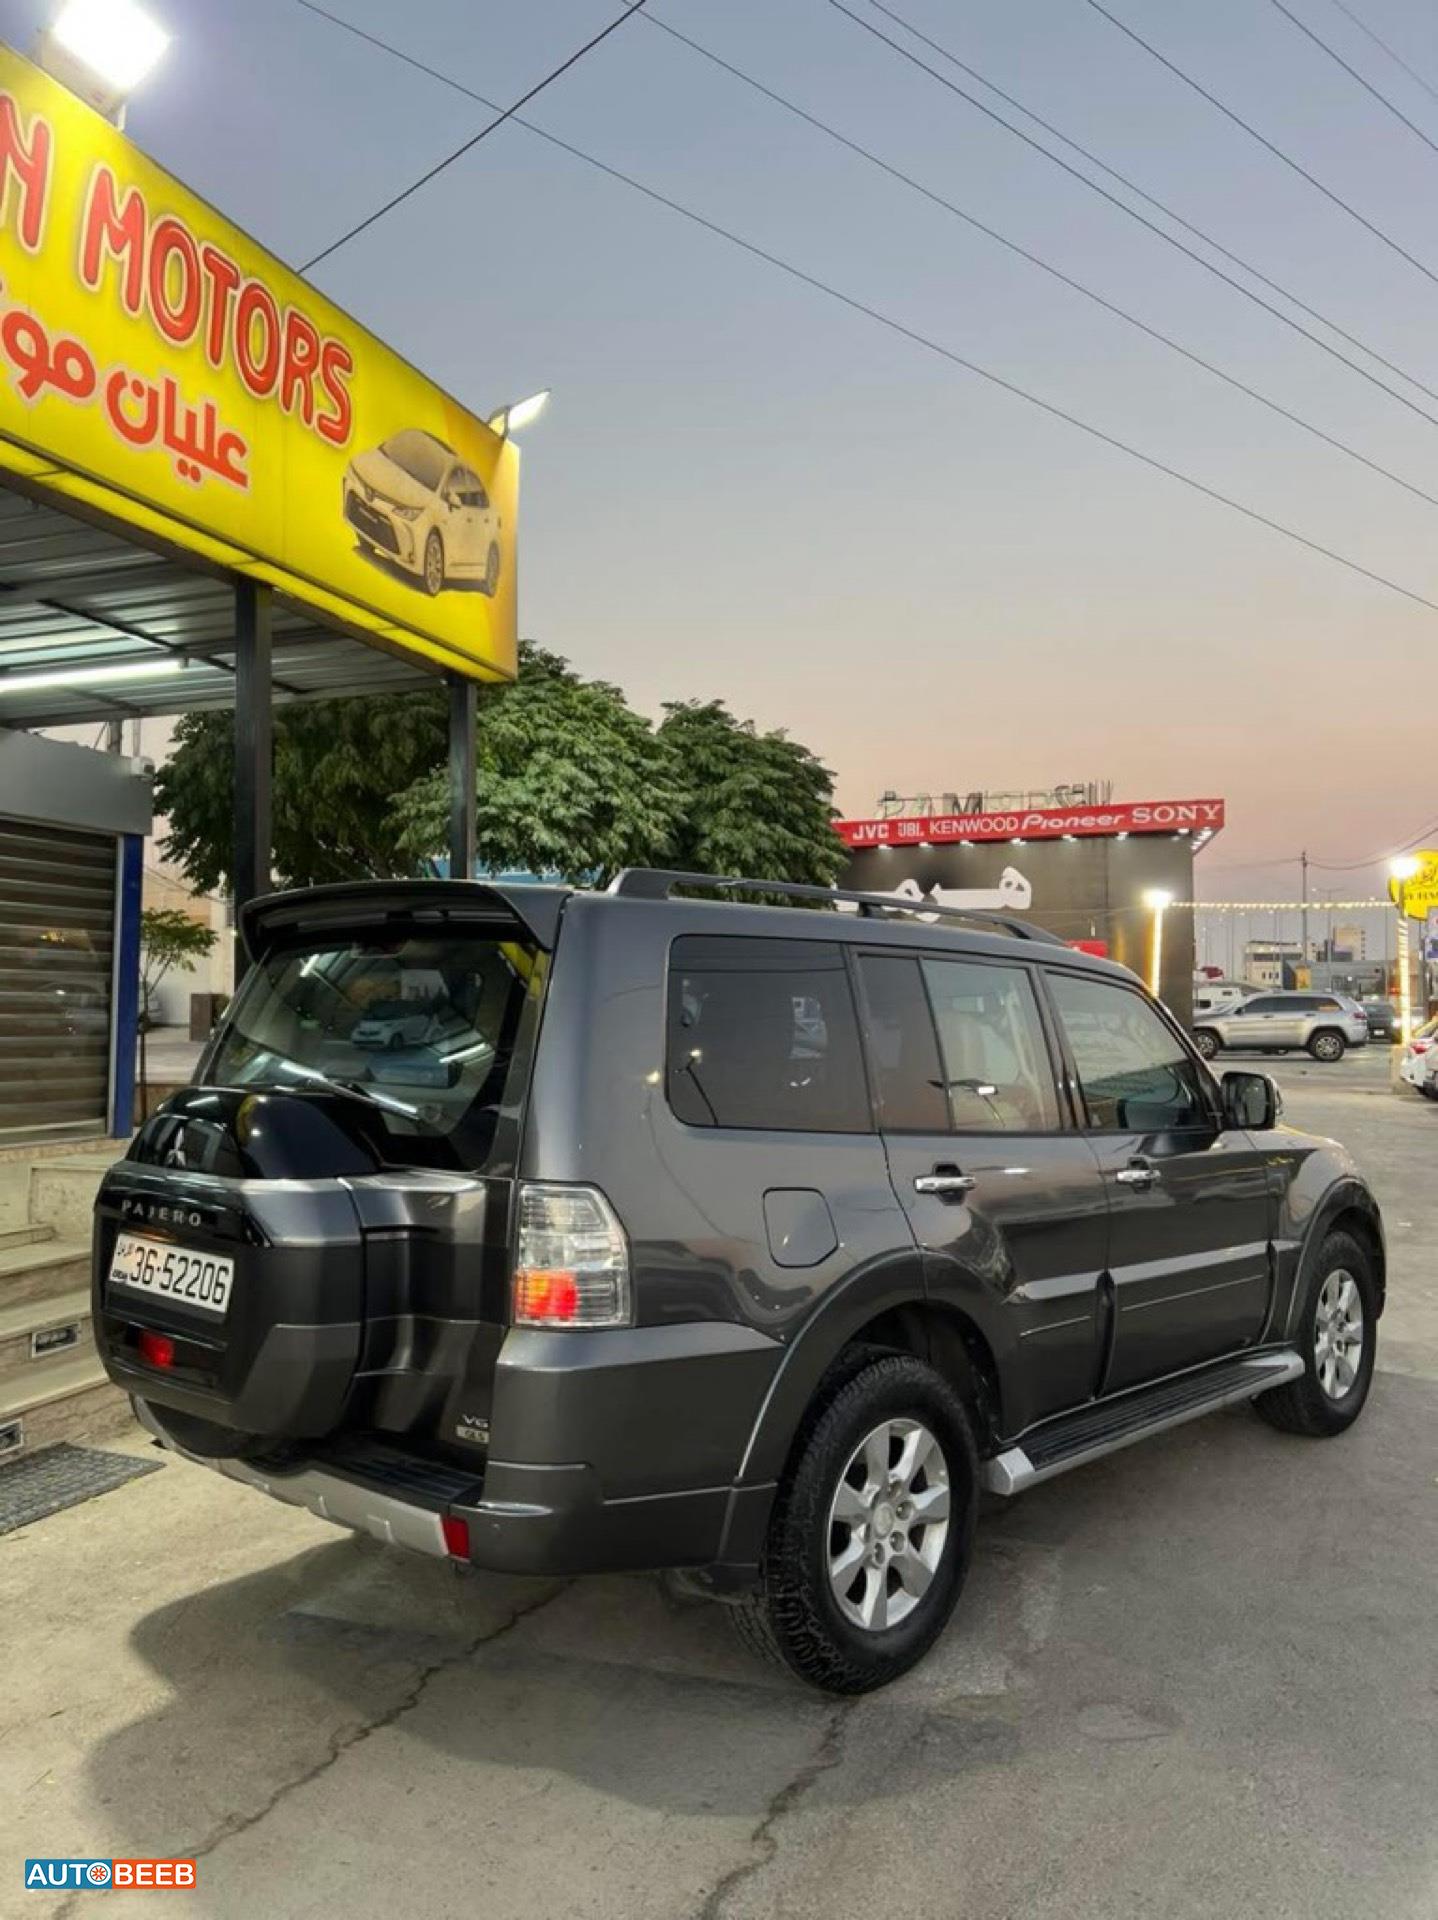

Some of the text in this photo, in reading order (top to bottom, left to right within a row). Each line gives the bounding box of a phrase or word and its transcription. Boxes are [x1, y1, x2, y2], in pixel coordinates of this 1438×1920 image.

[83, 167, 352, 445] MOTORS
[106, 370, 248, 487] عليان
[852, 822, 890, 841] JVC
[929, 816, 1019, 835] KENWOOD
[1021, 813, 1125, 831] Pioneer
[1131, 804, 1221, 824] SONY
[121, 1199, 202, 1227] PAJERO
